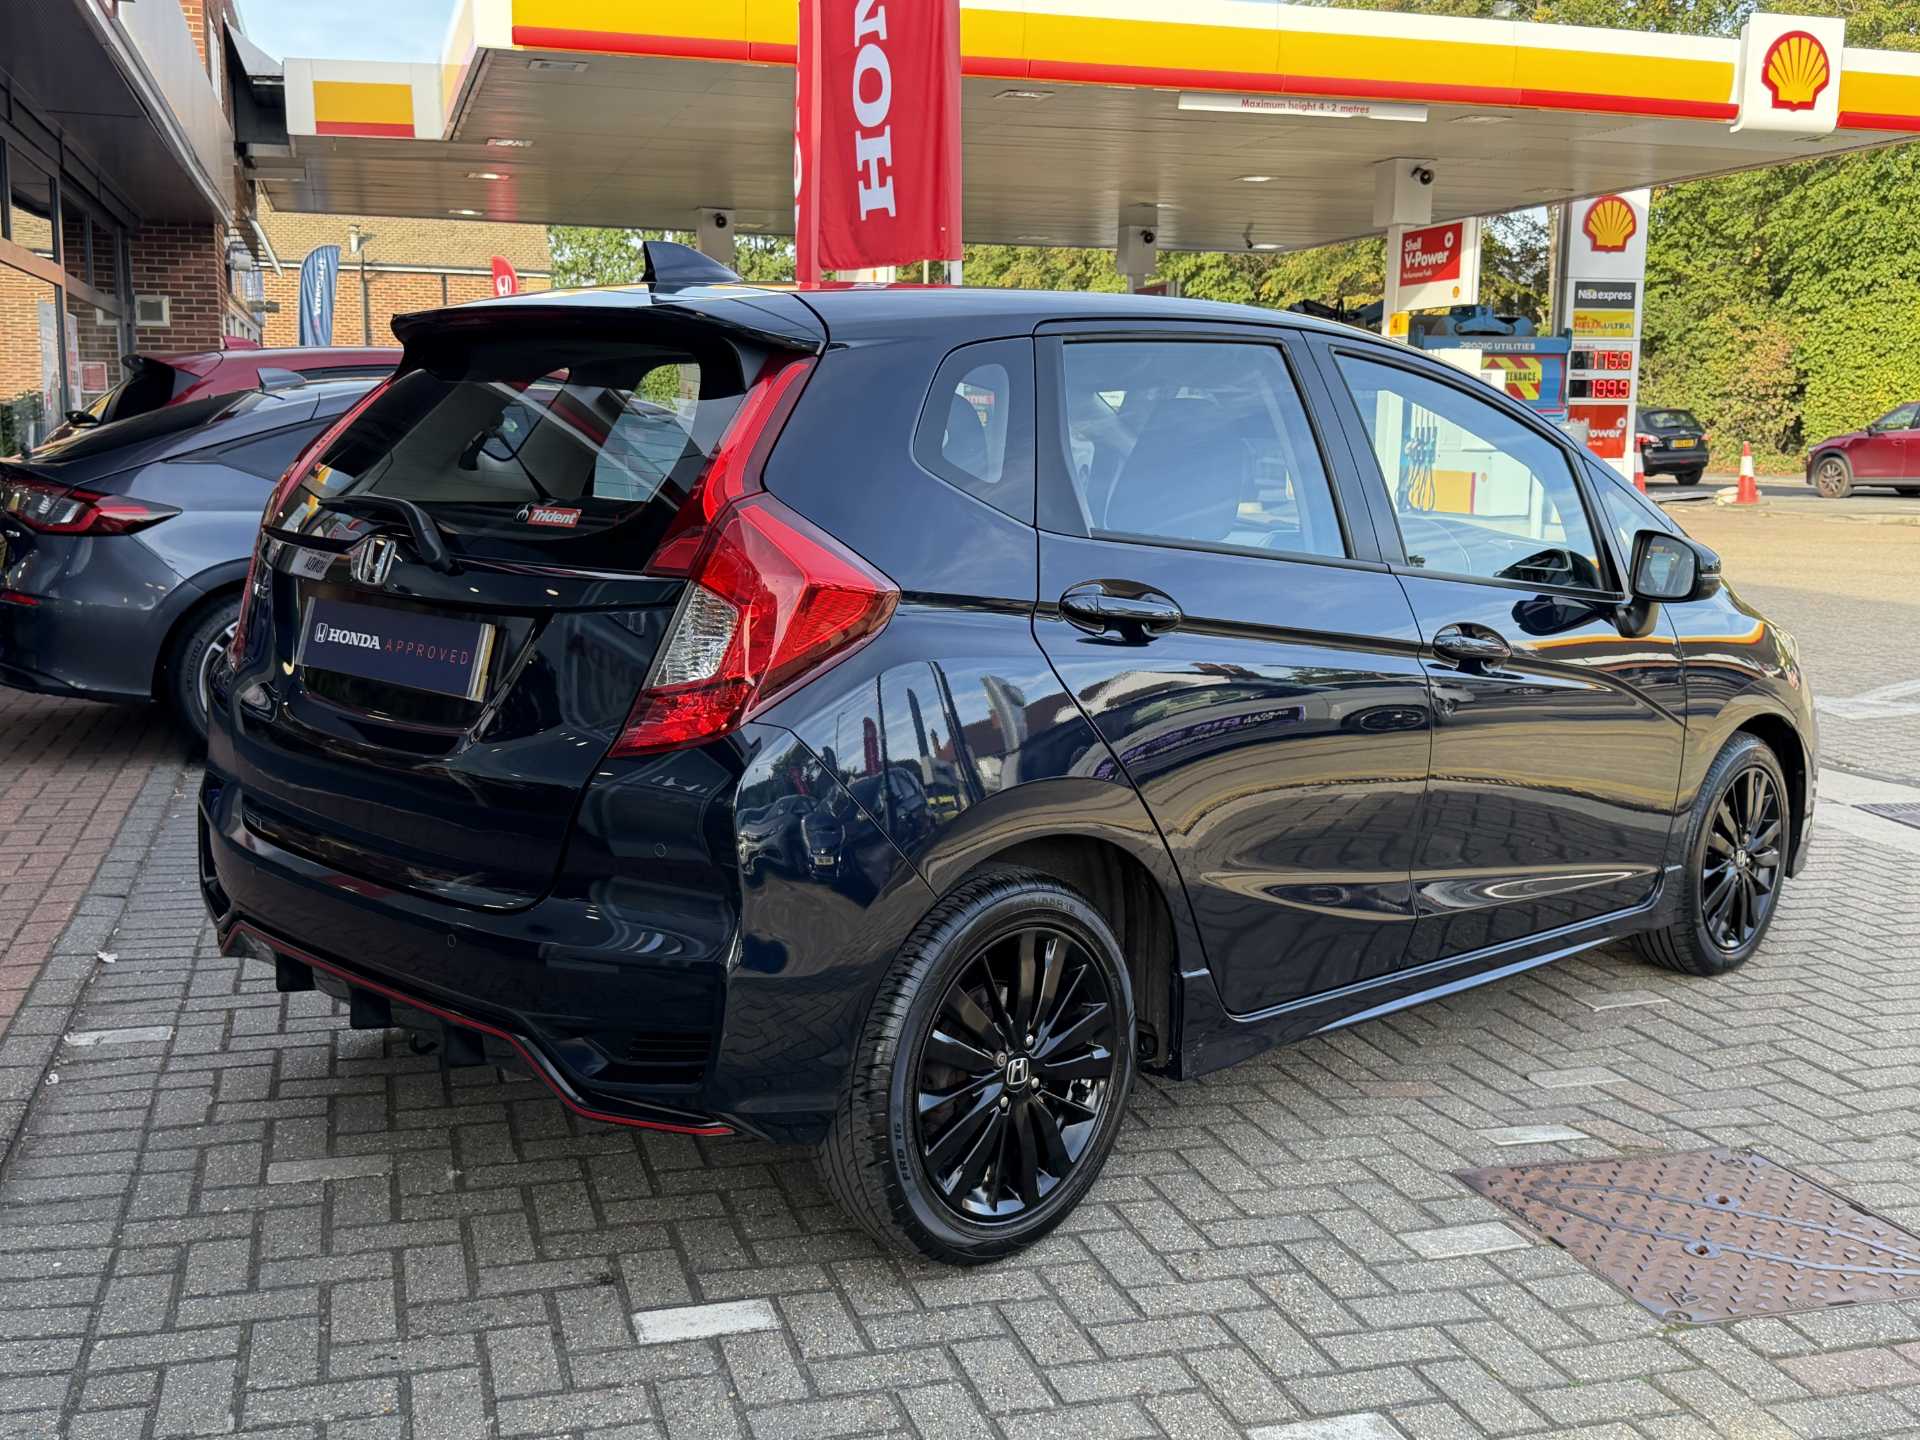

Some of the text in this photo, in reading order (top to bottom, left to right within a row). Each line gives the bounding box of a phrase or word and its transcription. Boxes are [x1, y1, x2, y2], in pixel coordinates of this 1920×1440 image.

[1242, 99, 1286, 109] Maximum
[1288, 99, 1316, 112] height
[1340, 105, 1370, 114] metres
[1404, 237, 1422, 251] Shell
[1404, 250, 1449, 269] V-Power
[1494, 342, 1536, 351] UTILITIES
[1505, 371, 1536, 382] TENANCE
[1589, 429, 1622, 439] ower
[531, 509, 578, 525] Trident
[327, 628, 381, 650] HONDA
[384, 638, 471, 666] APPROVED
